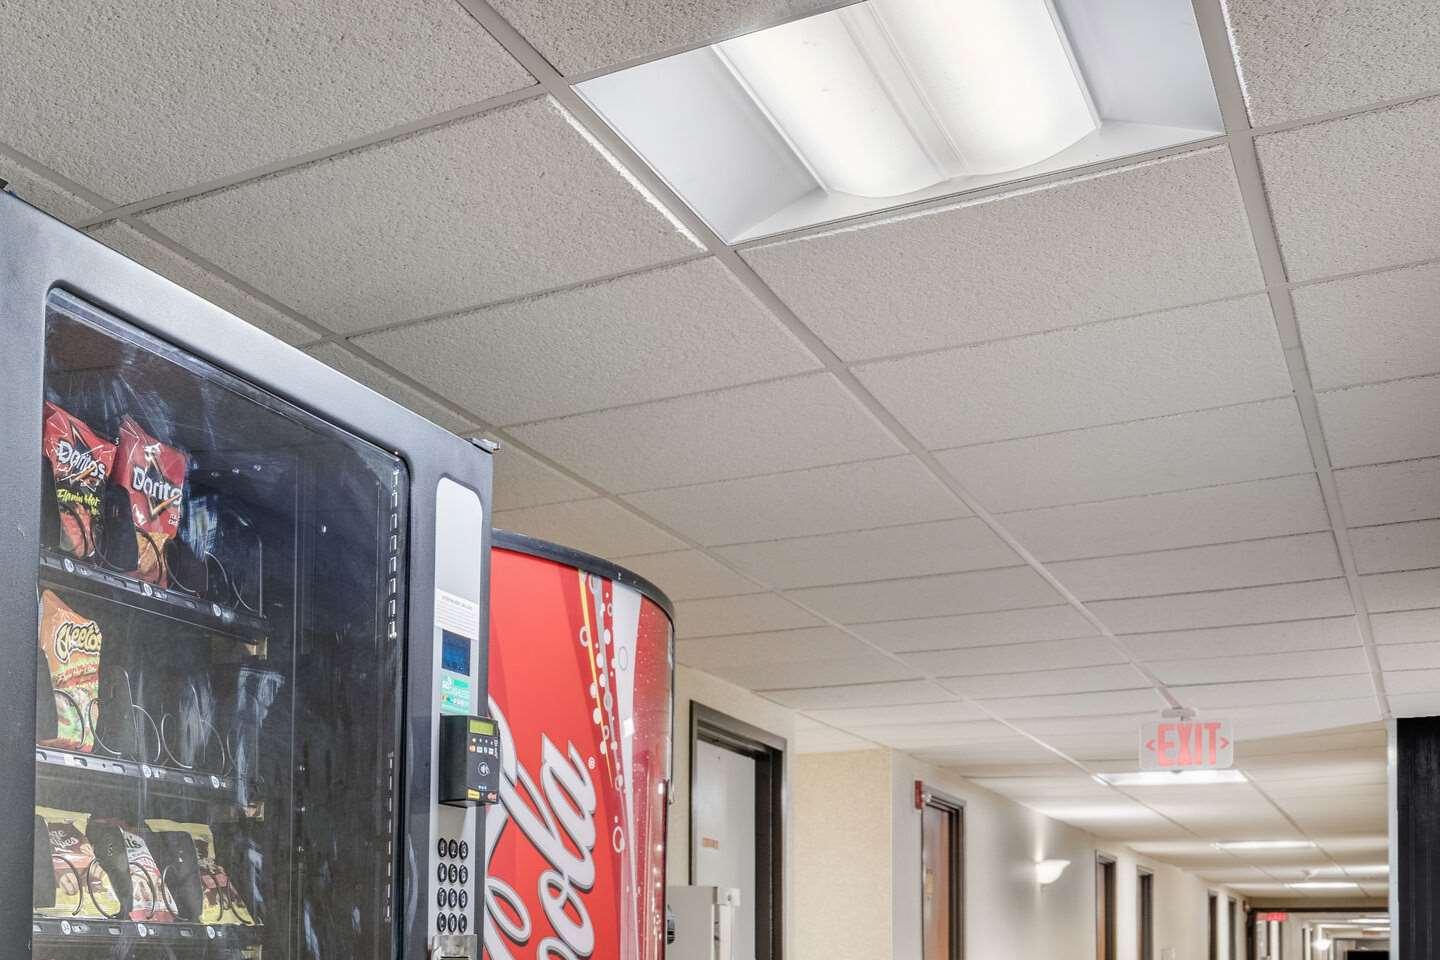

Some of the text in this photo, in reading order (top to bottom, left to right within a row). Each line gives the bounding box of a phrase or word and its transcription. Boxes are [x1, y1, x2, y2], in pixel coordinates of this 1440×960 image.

[57, 440, 105, 479] Doritos
[132, 465, 183, 505] Dorito
[55, 621, 102, 663] Cheetos
[1157, 722, 1221, 767] EXIT
